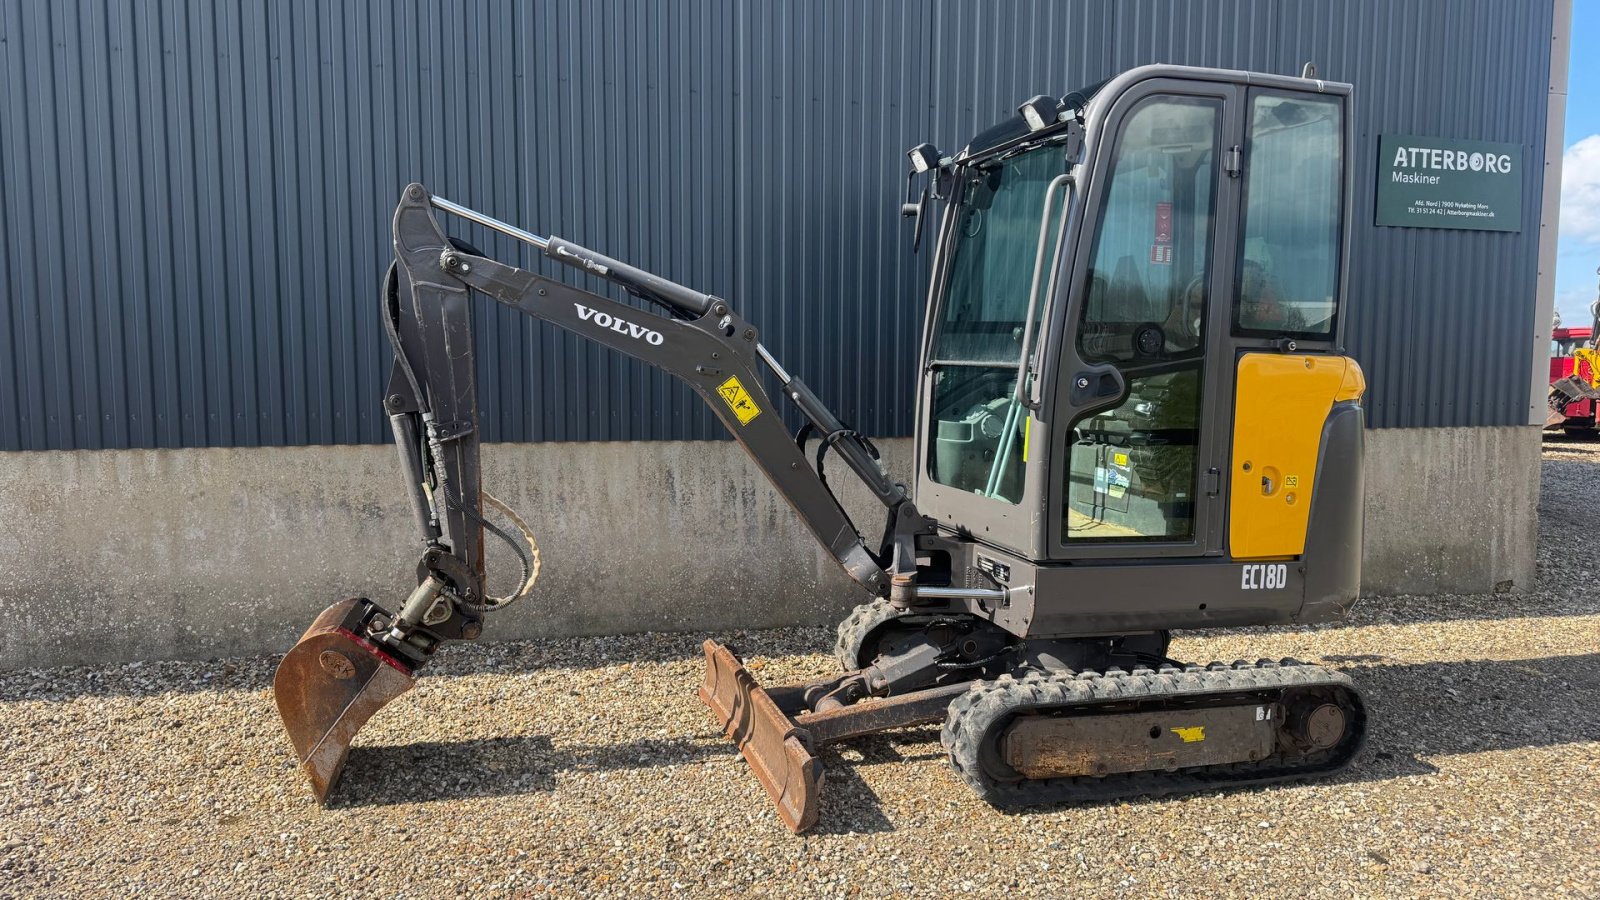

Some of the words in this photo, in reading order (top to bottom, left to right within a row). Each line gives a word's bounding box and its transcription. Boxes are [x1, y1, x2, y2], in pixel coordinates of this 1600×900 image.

[1393, 146, 1511, 173] ATTERBORG
[1392, 171, 1440, 185] Maskiner
[574, 302, 664, 346] VOLVO
[1241, 564, 1287, 590] EC18D
